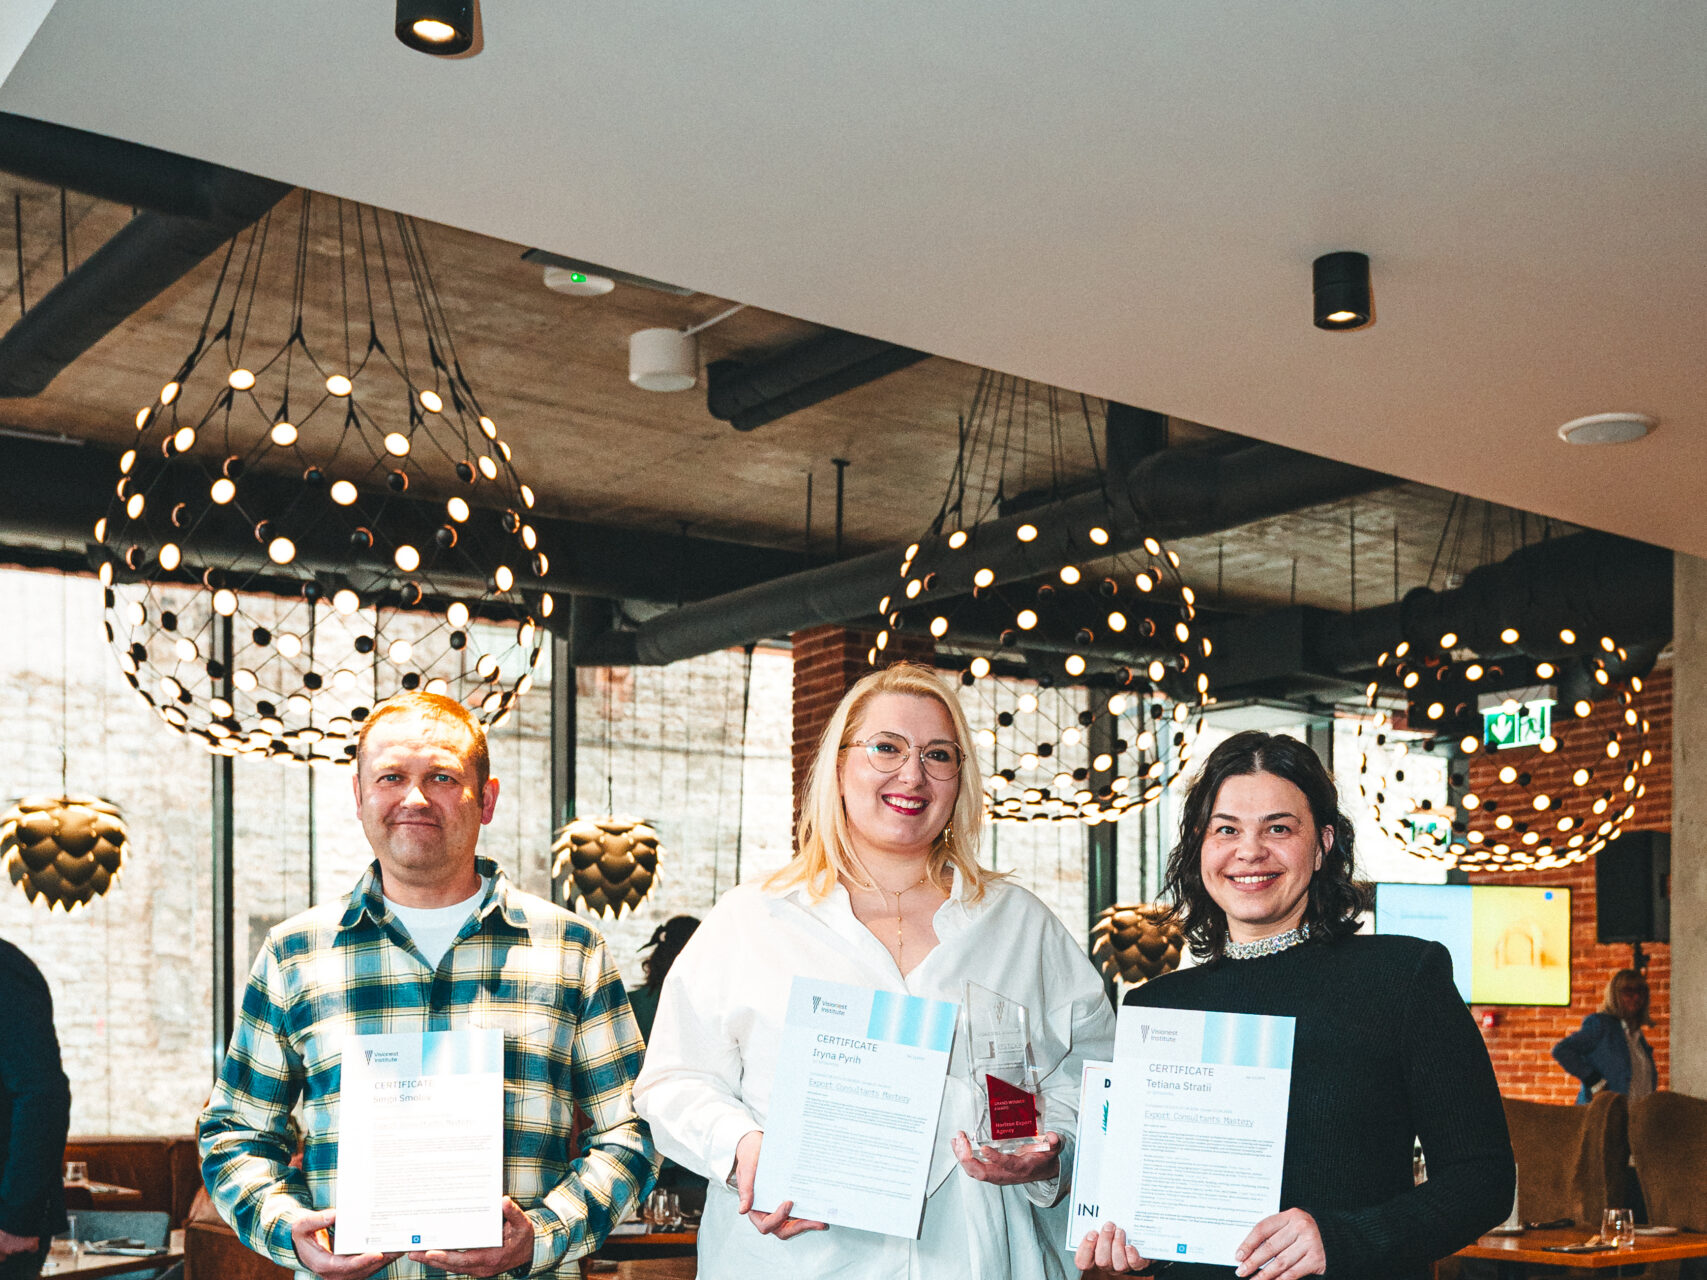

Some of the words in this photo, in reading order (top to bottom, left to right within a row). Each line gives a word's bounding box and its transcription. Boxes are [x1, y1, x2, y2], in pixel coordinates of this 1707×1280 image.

[821, 1007, 845, 1016] Institute
[1151, 1028, 1178, 1036] Visionest
[817, 1033, 878, 1053] CERTIFICATE
[813, 1048, 837, 1061] Iryna
[838, 1052, 862, 1065] Pyrih
[1149, 1063, 1215, 1077] CERTIFICATE
[374, 1080, 433, 1090] CERTIFICATE
[1146, 1078, 1181, 1090] Tetiana
[1144, 1110, 1170, 1120] Export
[1173, 1112, 1221, 1123] Consultants
[1223, 1116, 1254, 1128] Mastery
